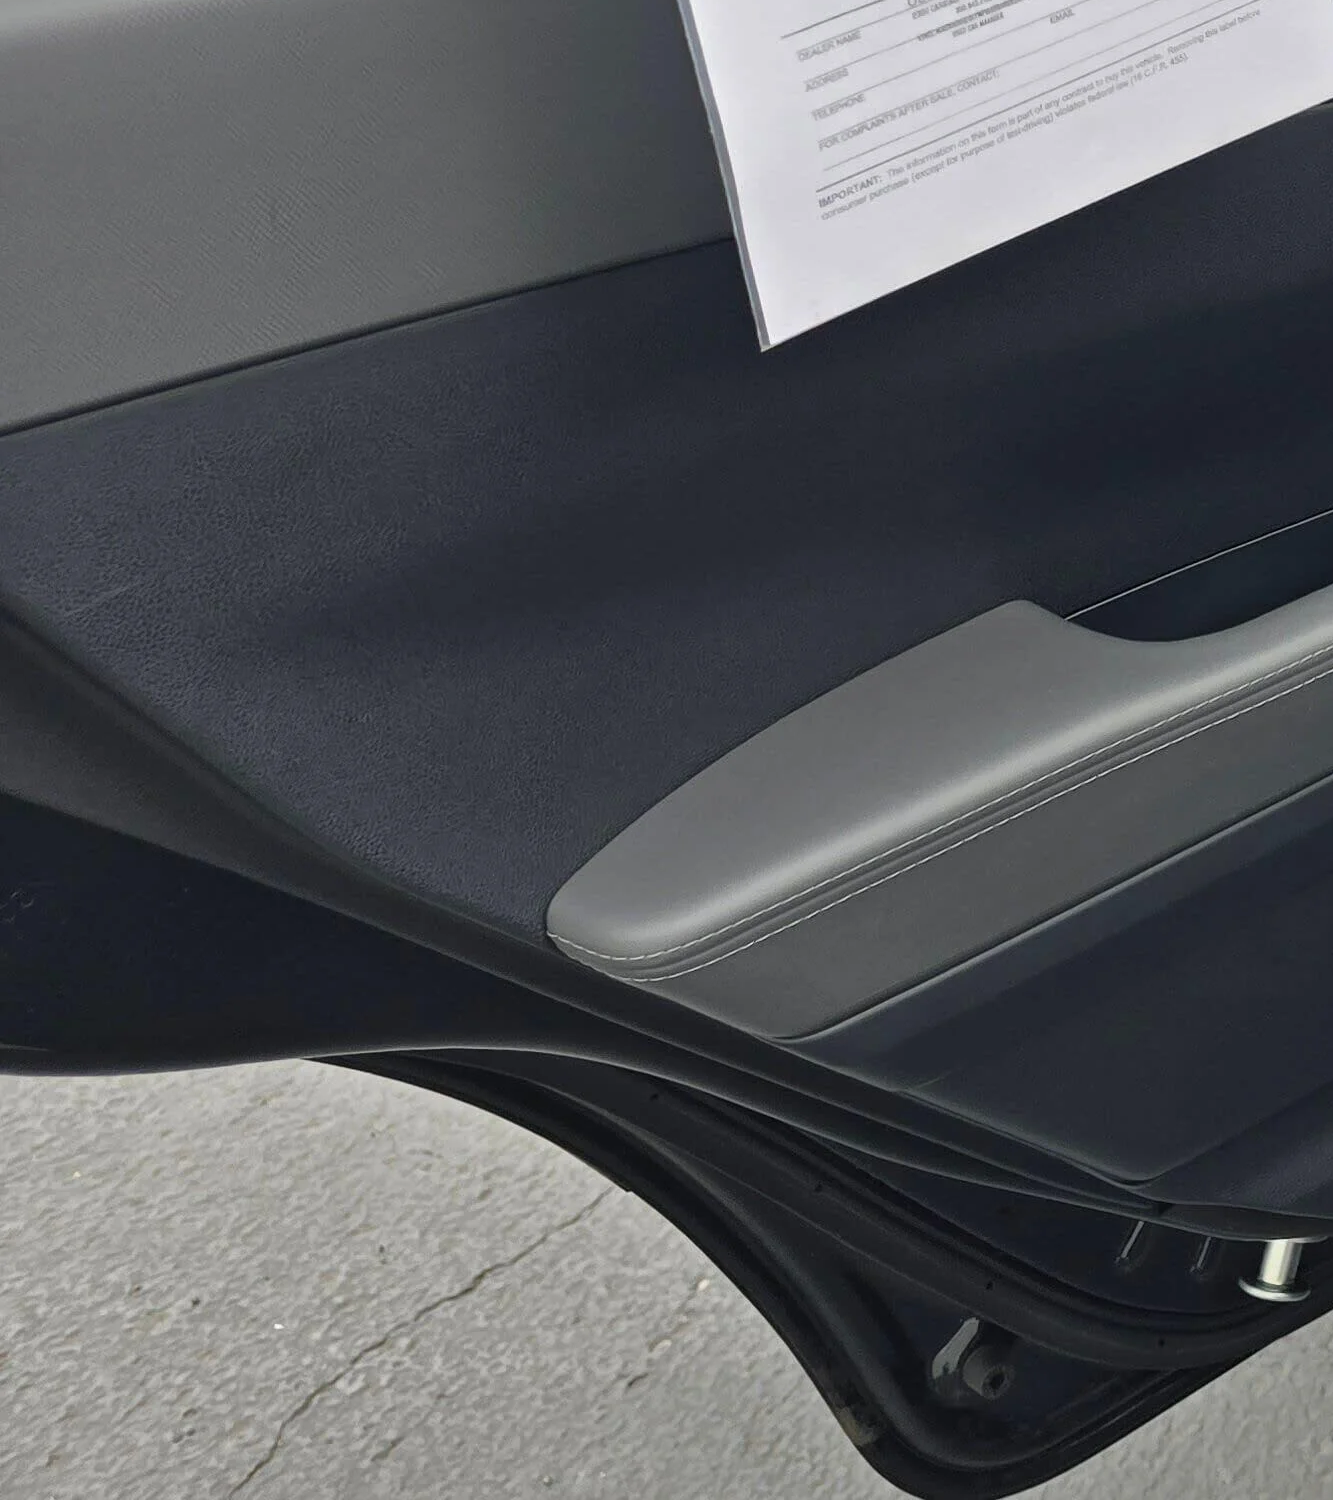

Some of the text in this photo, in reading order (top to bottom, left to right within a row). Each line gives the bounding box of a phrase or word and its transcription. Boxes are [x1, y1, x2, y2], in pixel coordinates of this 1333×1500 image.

[1049, 6, 1074, 23] EMAIL
[797, 29, 860, 61] DEALER NAME
[805, 68, 848, 92] ADDRESS
[812, 94, 865, 120] TELEPHONE
[818, 175, 881, 207] IMPORTANT:
[887, 166, 904, 176] The
[908, 144, 956, 169] information
[958, 138, 969, 148] on
[970, 131, 986, 141] this
[987, 121, 1007, 134] form
[1016, 109, 1033, 122] part
[1034, 104, 1043, 114] of
[1044, 98, 1059, 109] any
[1062, 82, 1094, 101] contract
[1105, 72, 1118, 83] buy
[1120, 65, 1133, 76] this
[1135, 54, 1162, 68] vehicle.
[1167, 35, 1204, 54] Removing
[1205, 28, 1218, 37] this
[1219, 18, 1236, 31] label
[1237, 9, 1260, 23] before
[818, 70, 999, 151] FOR COMPLAINTS AFTER SALE, CONTACT:
[821, 195, 866, 220] consumer
[869, 178, 909, 200] purchase
[911, 161, 944, 183] (except
[946, 155, 958, 166] for
[960, 140, 994, 161] purpose
[996, 133, 1005, 144] of
[1054, 100, 1086, 117] violates
[1087, 84, 1114, 102] federal
[1116, 80, 1129, 90] law
